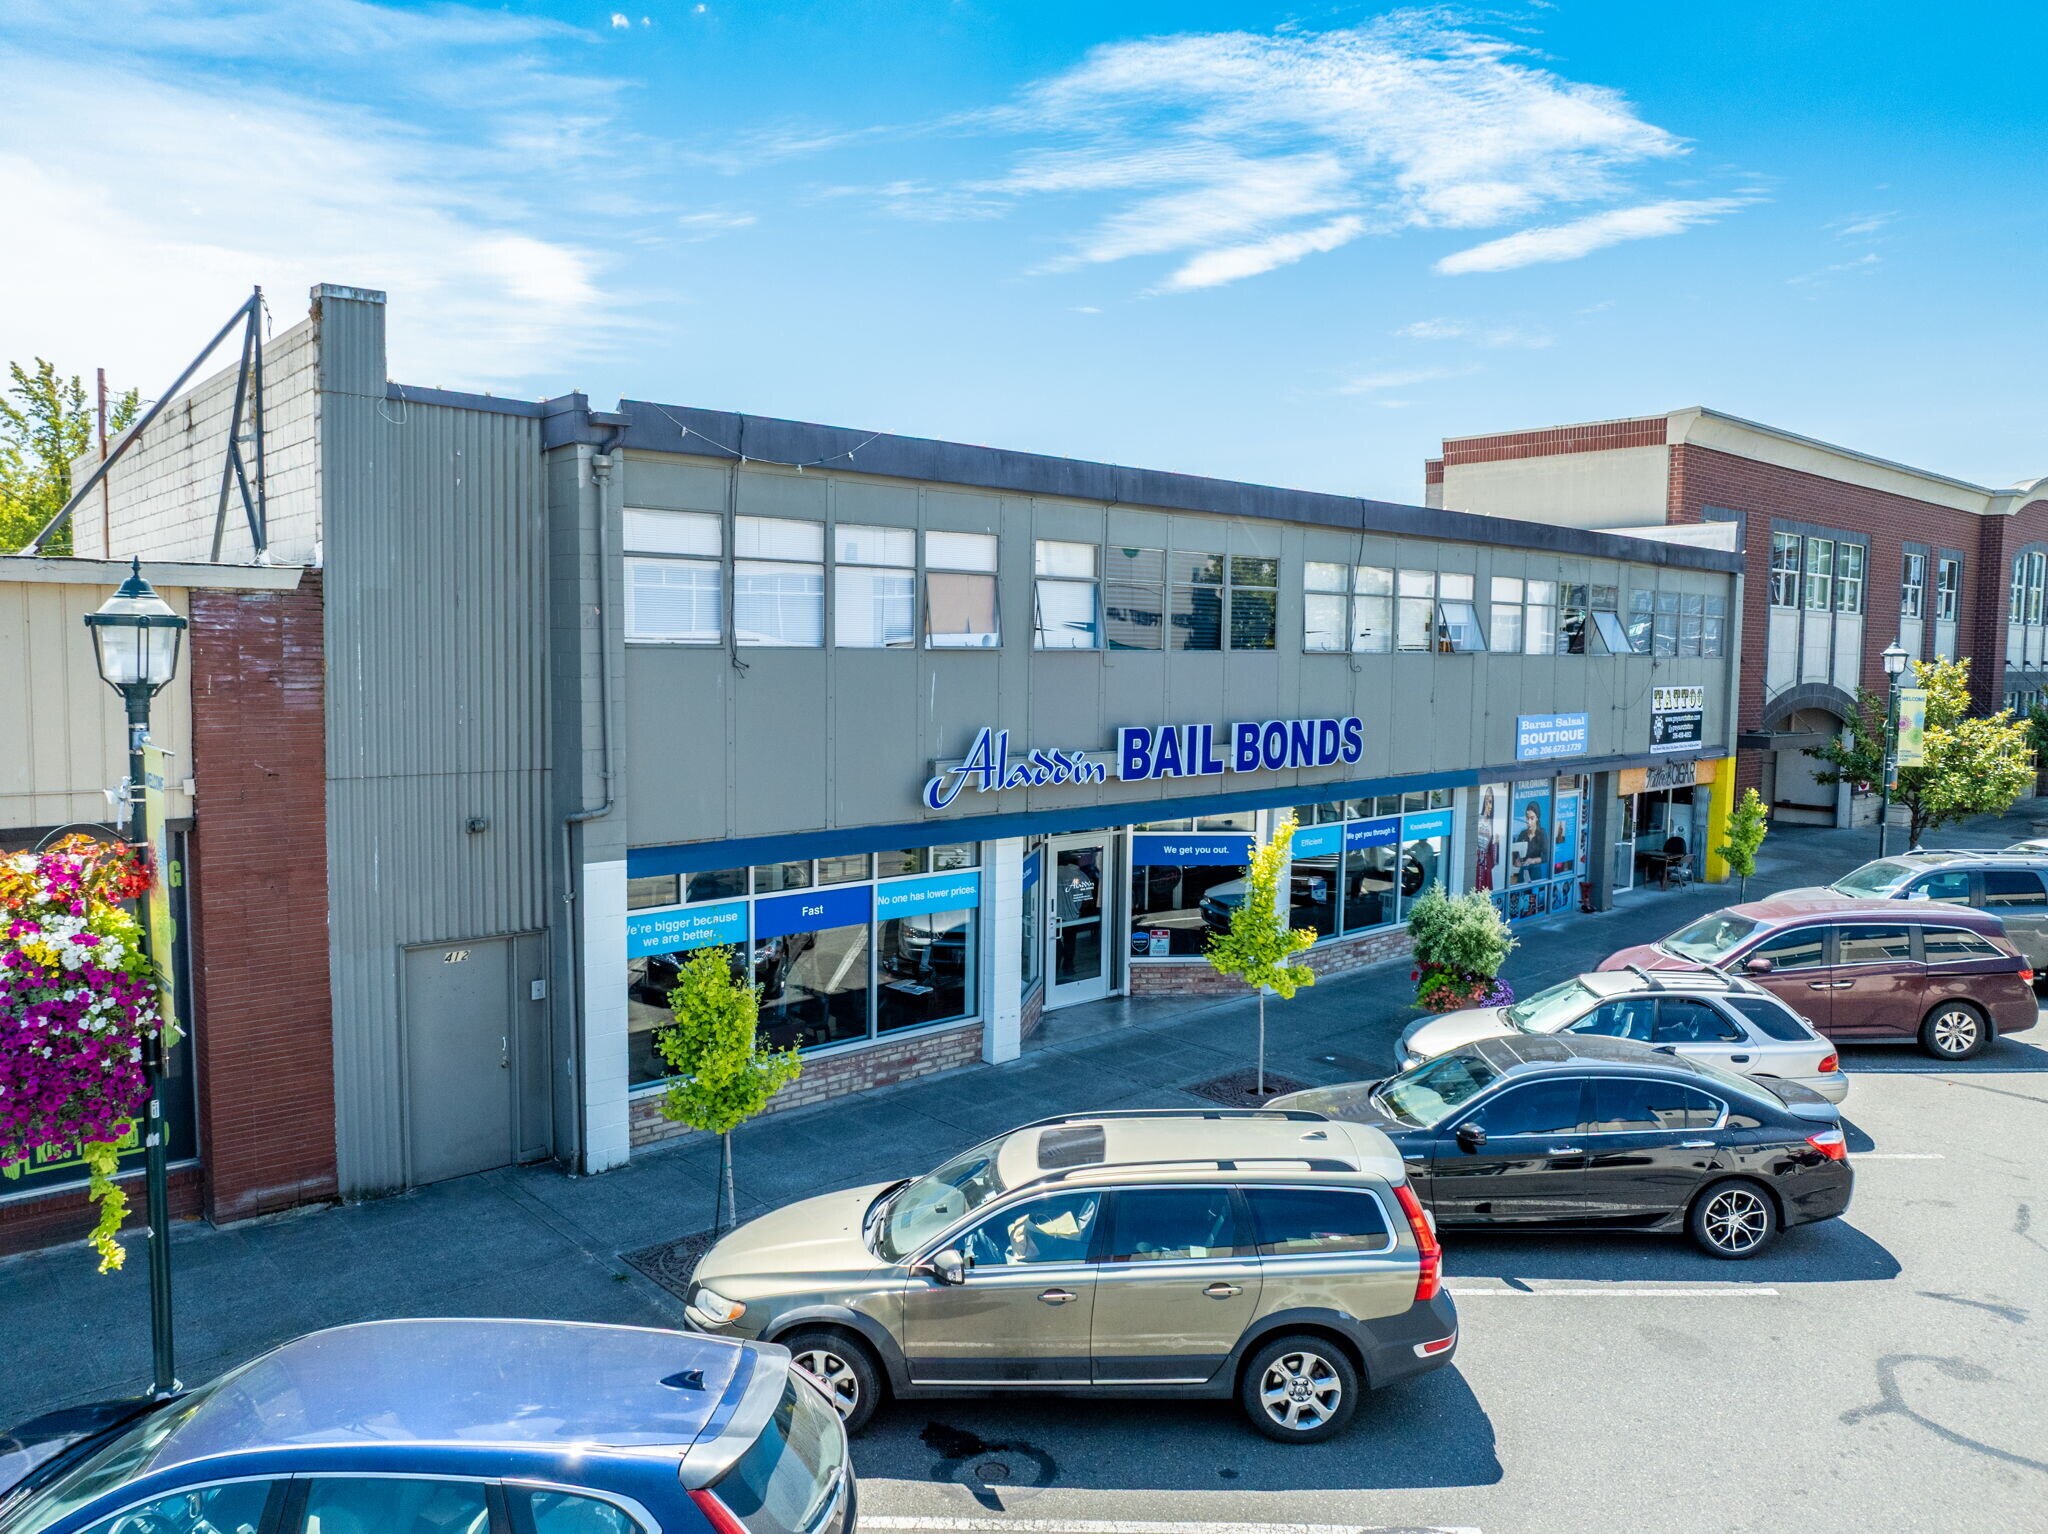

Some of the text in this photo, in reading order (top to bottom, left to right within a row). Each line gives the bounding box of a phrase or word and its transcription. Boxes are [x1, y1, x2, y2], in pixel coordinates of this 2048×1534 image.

[1654, 689, 1703, 710] TATTOO
[1521, 720, 1553, 730] Baran
[1520, 728, 1585, 746] BOUTIQUE
[923, 716, 1365, 810] Aladdin BAIL BONDS
[1355, 831, 1363, 841] get
[1363, 831, 1373, 840] you
[1373, 828, 1391, 837] through
[1301, 838, 1323, 847] Efficient
[1163, 845, 1230, 856] We get you out.
[878, 885, 977, 906] No one has lower prices.
[802, 904, 824, 917] Fast
[655, 918, 691, 934] bigger
[693, 912, 738, 927] because
[643, 929, 717, 947] we are better.
[444, 950, 470, 962] 412
